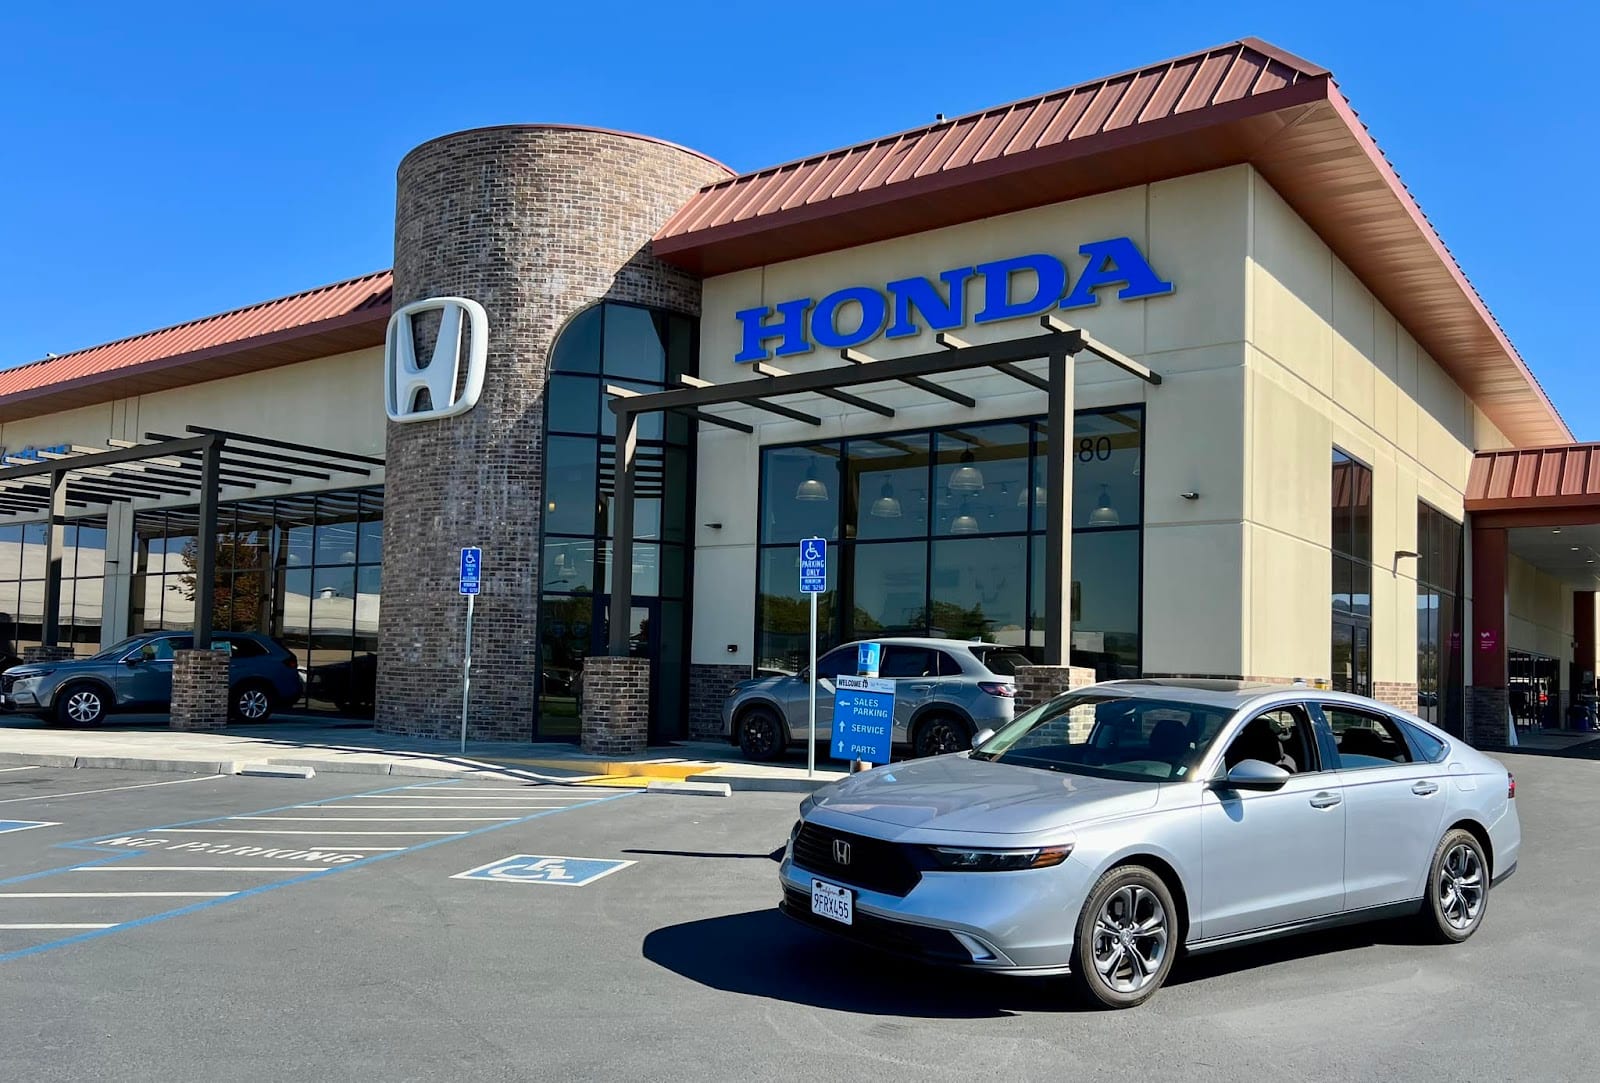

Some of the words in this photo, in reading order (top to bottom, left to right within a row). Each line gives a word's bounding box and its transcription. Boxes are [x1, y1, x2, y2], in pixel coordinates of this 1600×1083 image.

[734, 237, 1175, 364] HONDA
[1073, 436, 1112, 463] 80
[802, 560, 824, 568] PARKING
[806, 568, 820, 576] ONLY
[838, 679, 862, 688] WELCOME
[862, 679, 869, 689] TO
[853, 697, 879, 707] SALES
[853, 707, 888, 718] PARKING
[851, 723, 885, 735] SERVICE
[850, 744, 877, 755] PARTS
[94, 836, 169, 848] NO
[164, 841, 365, 864] PARKING
[814, 893, 849, 919] 9FRX455
